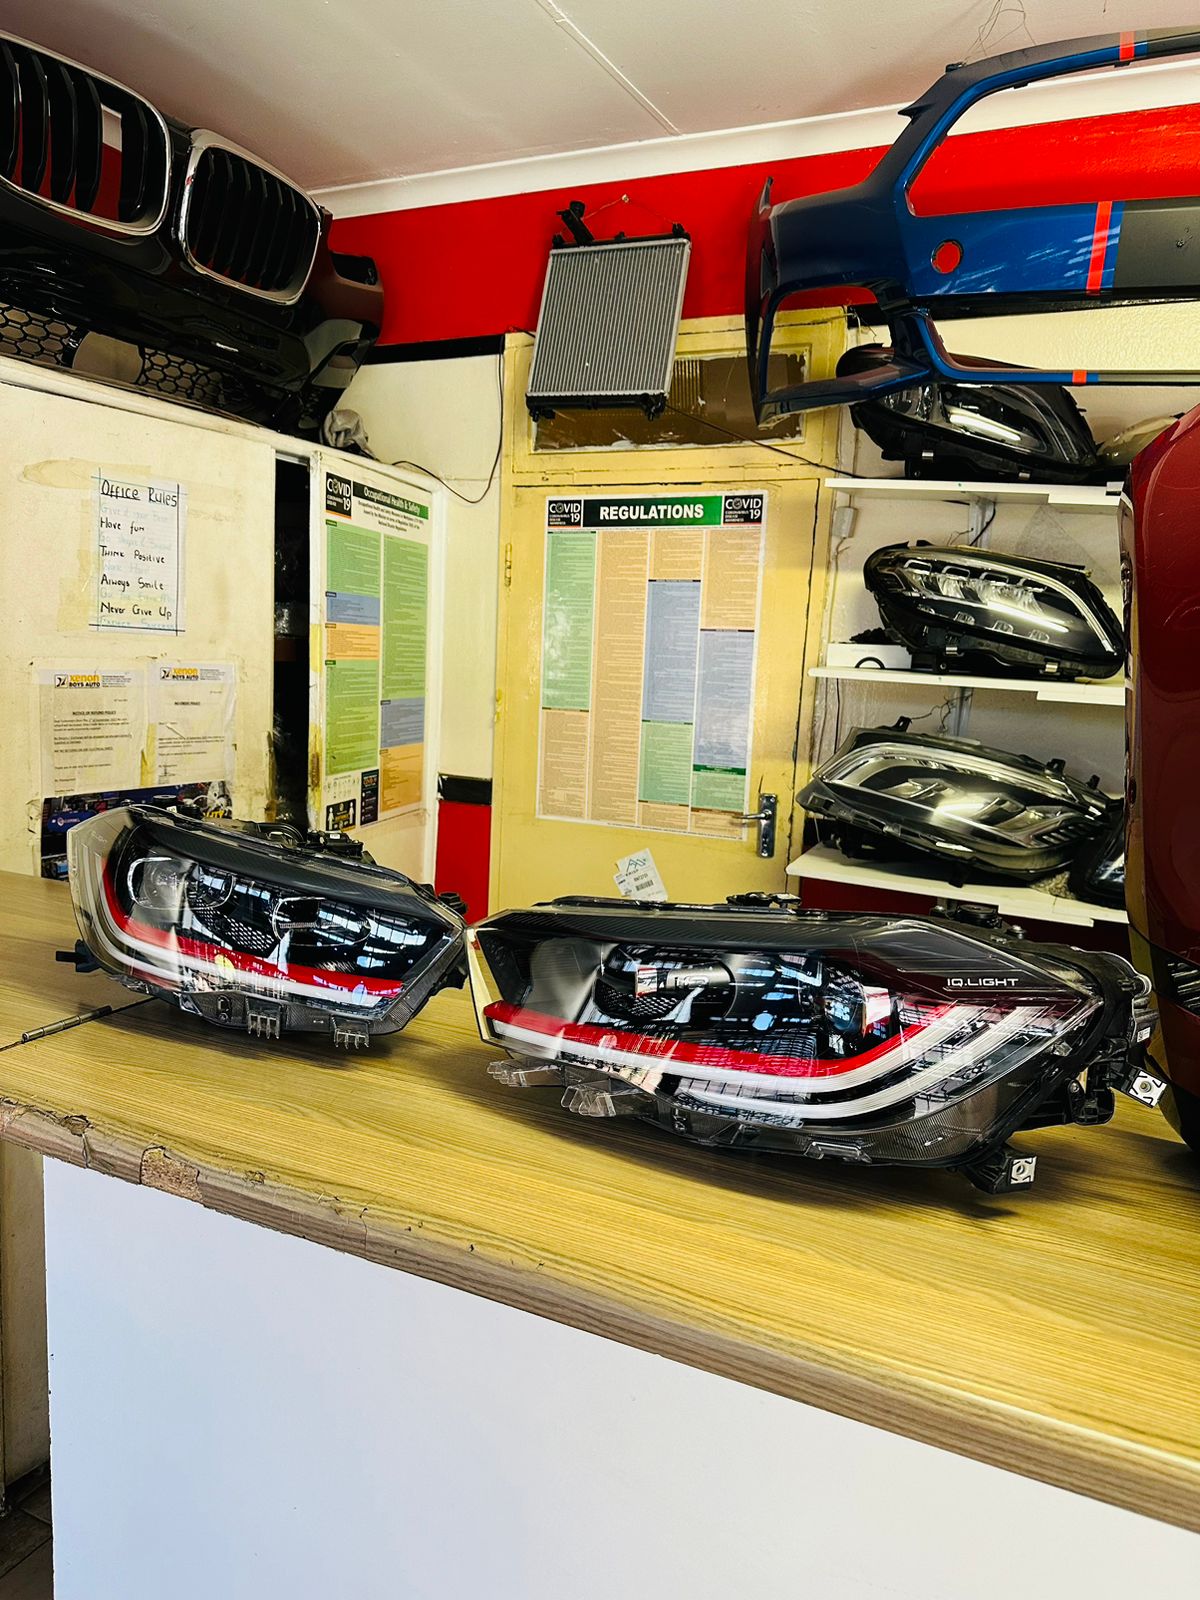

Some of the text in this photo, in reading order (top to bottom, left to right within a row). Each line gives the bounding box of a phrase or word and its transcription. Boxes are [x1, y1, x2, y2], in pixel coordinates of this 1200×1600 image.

[101, 479, 177, 507] Office Rules
[327, 478, 351, 497] COVID
[343, 497, 351, 511] 19
[363, 487, 391, 503] Occupational
[391, 496, 404, 508] Health
[408, 501, 420, 515] Safety
[549, 502, 580, 513] COVID
[725, 497, 762, 509] COVID
[570, 513, 580, 522] 19
[599, 504, 704, 520] REGULATIONS
[749, 509, 761, 519] 19
[100, 517, 145, 534] Have fun
[134, 549, 165, 563] Positive
[100, 573, 164, 592] Always Smile
[100, 602, 172, 620] Never Give Up
[69, 674, 100, 682] xenon
[947, 978, 1019, 987] IQ.LIGHT
